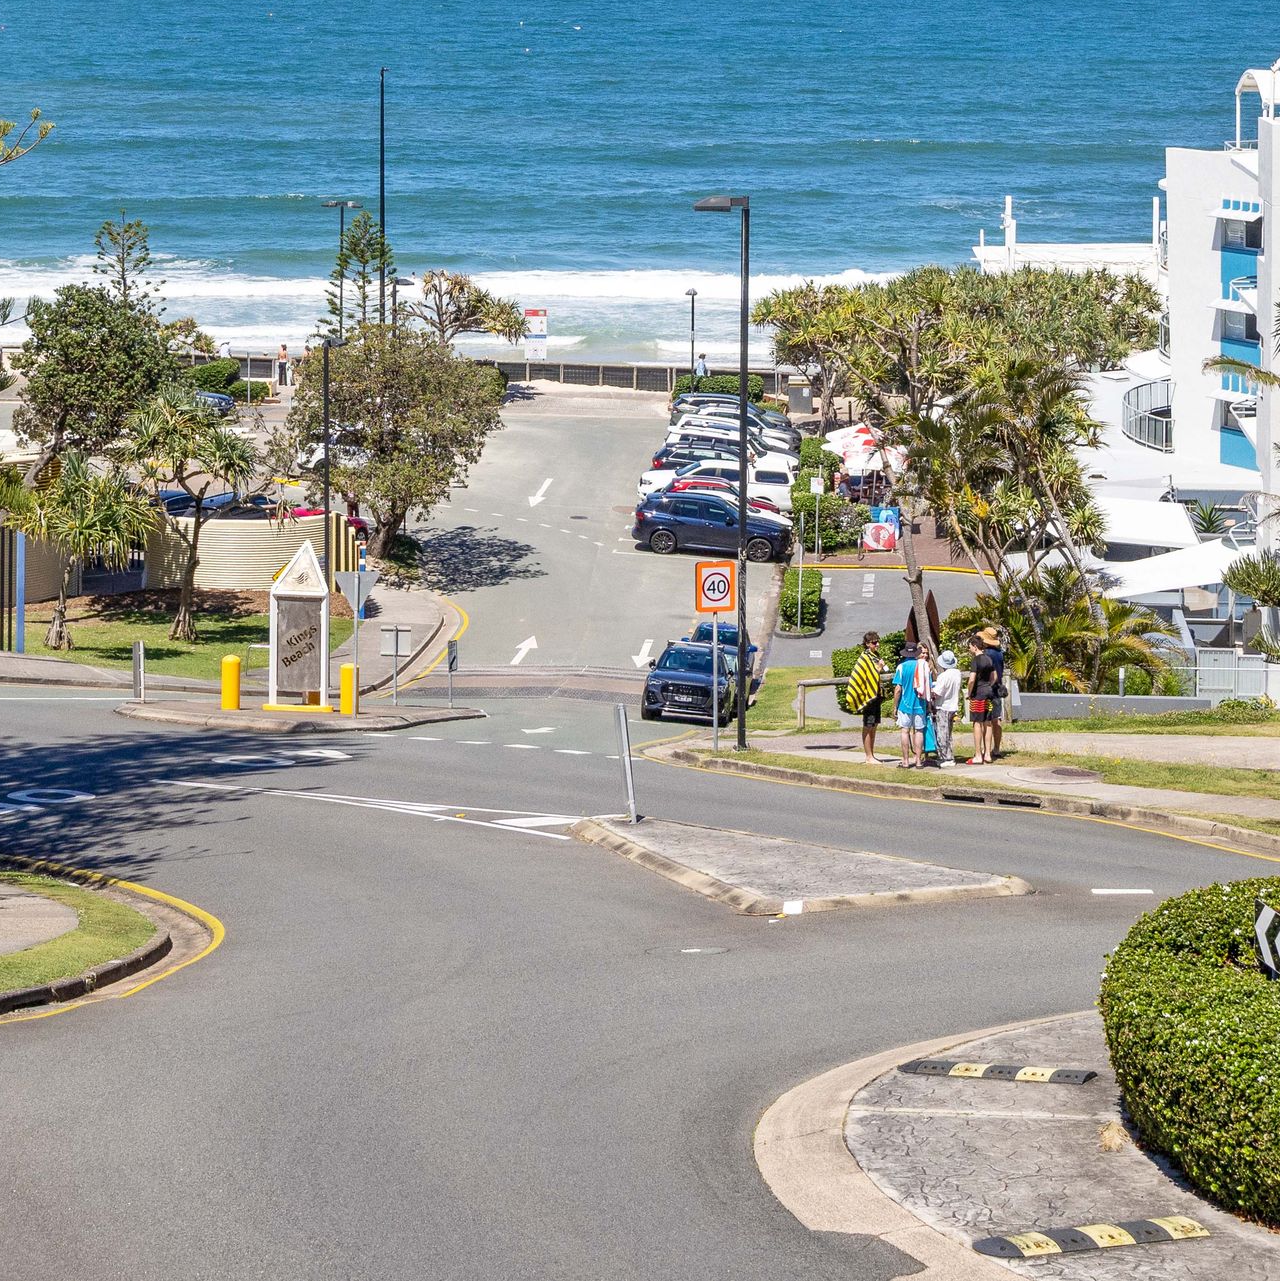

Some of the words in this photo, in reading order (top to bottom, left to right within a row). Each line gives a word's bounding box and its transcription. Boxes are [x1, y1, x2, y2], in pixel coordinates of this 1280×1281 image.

[706, 580, 726, 594] 40
[286, 624, 317, 646] Kings
[281, 642, 315, 667] Beach
